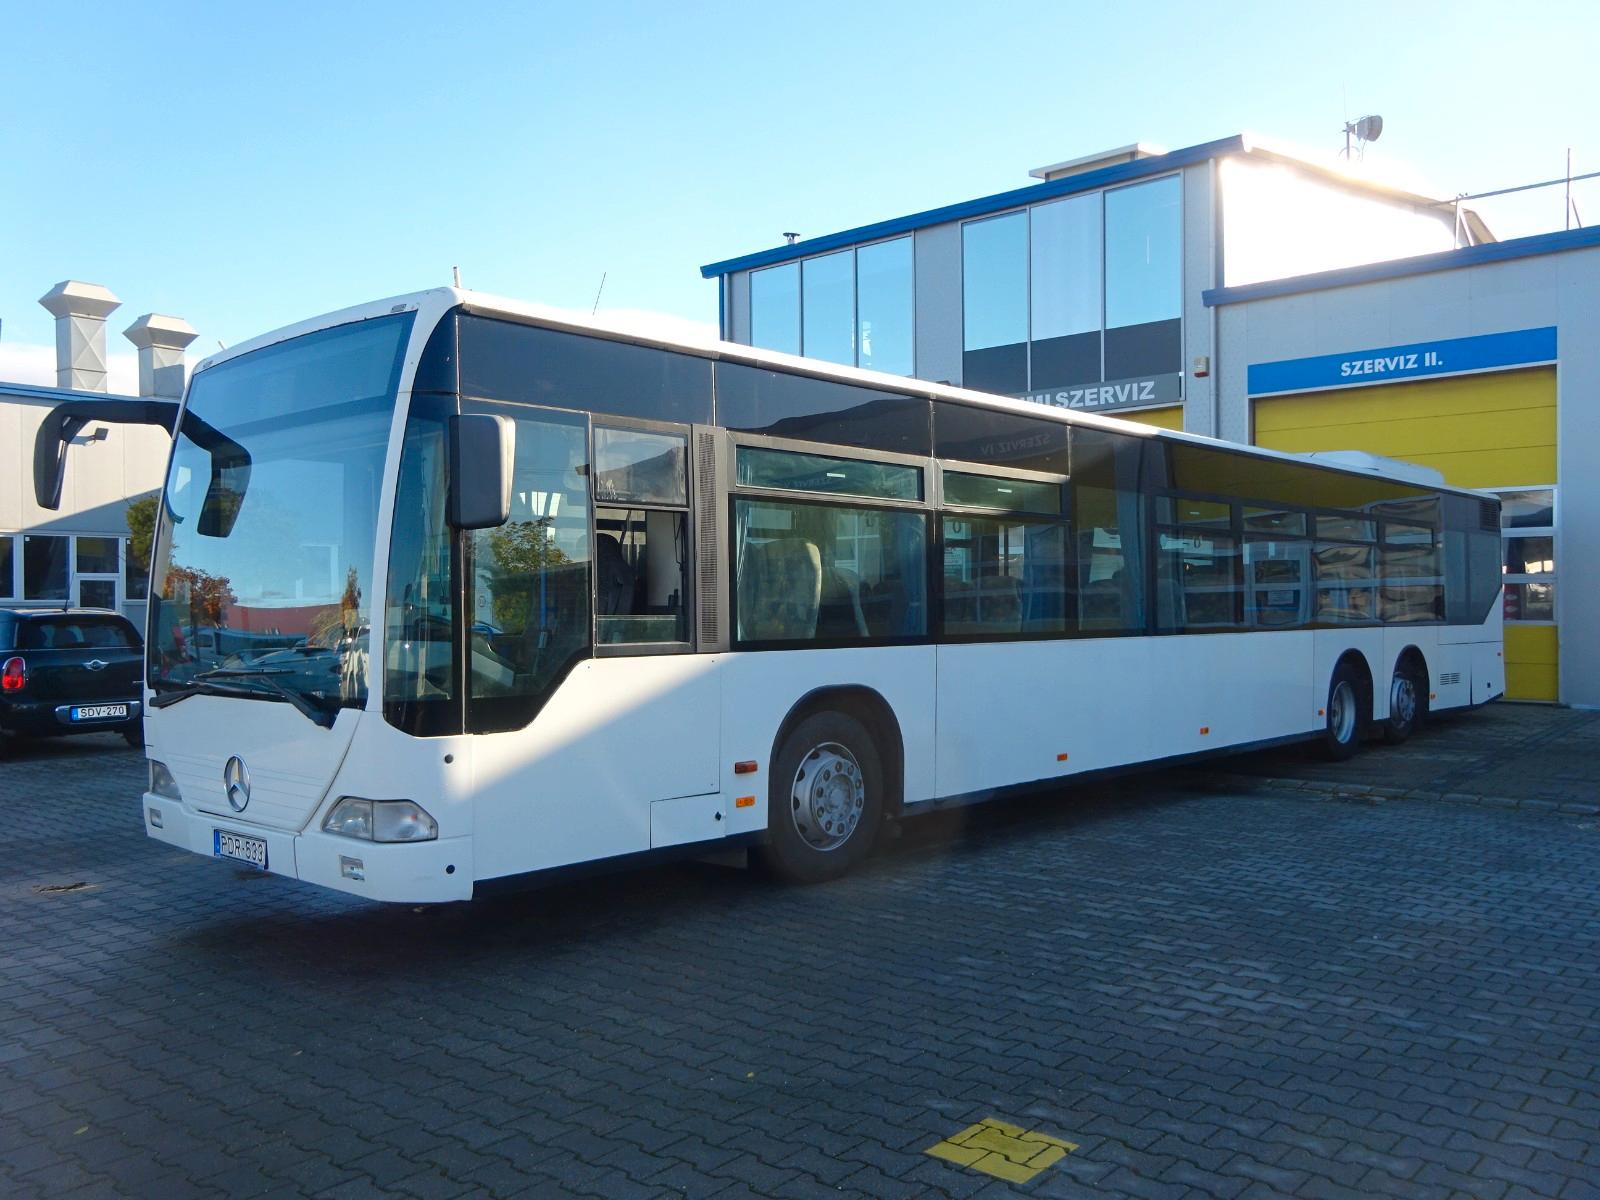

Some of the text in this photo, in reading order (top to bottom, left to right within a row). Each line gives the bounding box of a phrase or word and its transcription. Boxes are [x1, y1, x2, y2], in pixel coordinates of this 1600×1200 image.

[1341, 352, 1443, 377] SZERVIZ II.
[1055, 381, 1155, 409] SZERVIZ
[80, 706, 125, 718] SDV-270
[221, 835, 264, 862] PDR-533
